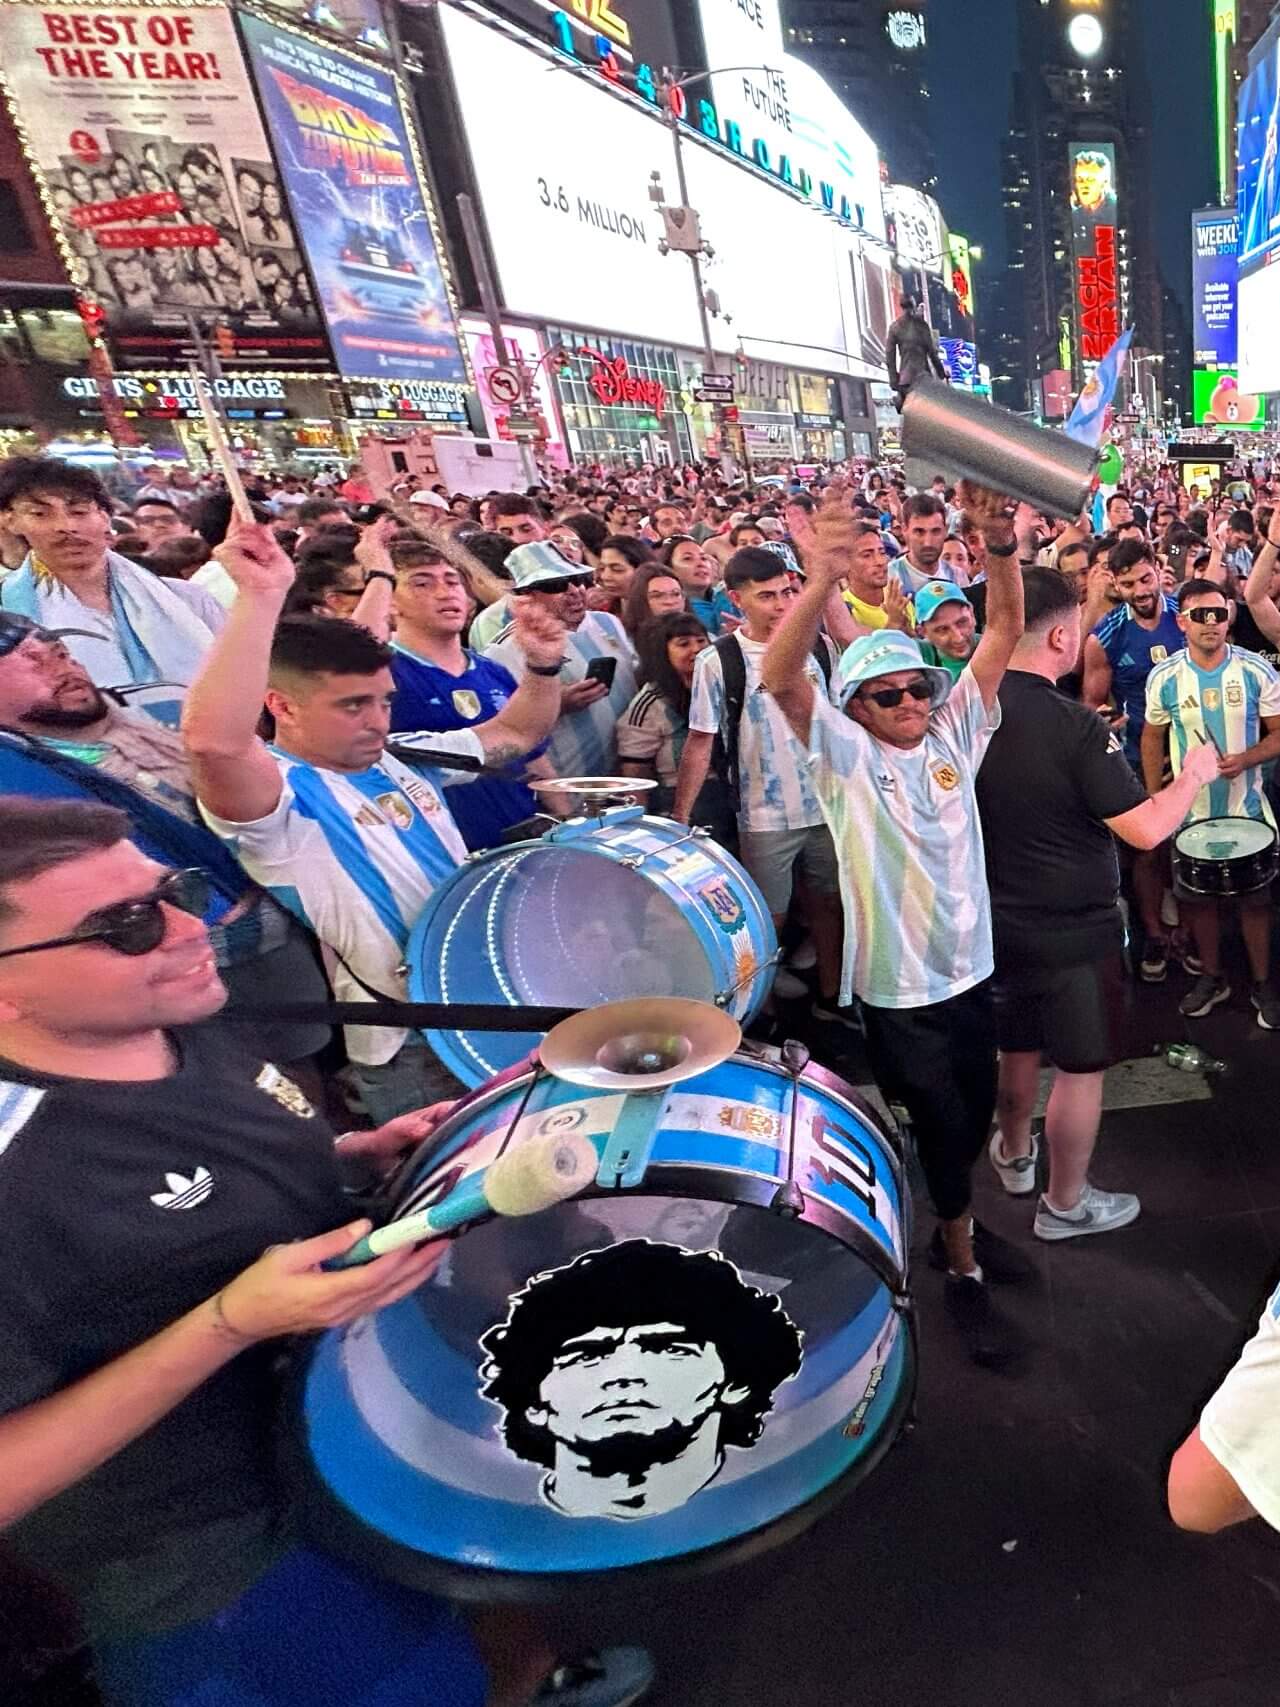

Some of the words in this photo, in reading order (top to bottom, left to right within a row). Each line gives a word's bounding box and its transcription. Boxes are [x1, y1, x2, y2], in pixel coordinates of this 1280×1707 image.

[42, 12, 138, 45] BEST
[147, 15, 195, 46] OF
[36, 48, 113, 78] THE
[115, 51, 221, 80] YEAR!
[763, 64, 788, 103] THE
[743, 76, 793, 134] FUTURE
[697, 98, 865, 228] BROADWAY
[537, 176, 569, 214] 3.6
[577, 195, 647, 244] MILLION
[1197, 246, 1217, 257] with
[1078, 257, 1100, 358] ZACH
[1095, 225, 1118, 358] BRYAN
[400, 383, 465, 403] LUGGAGE
